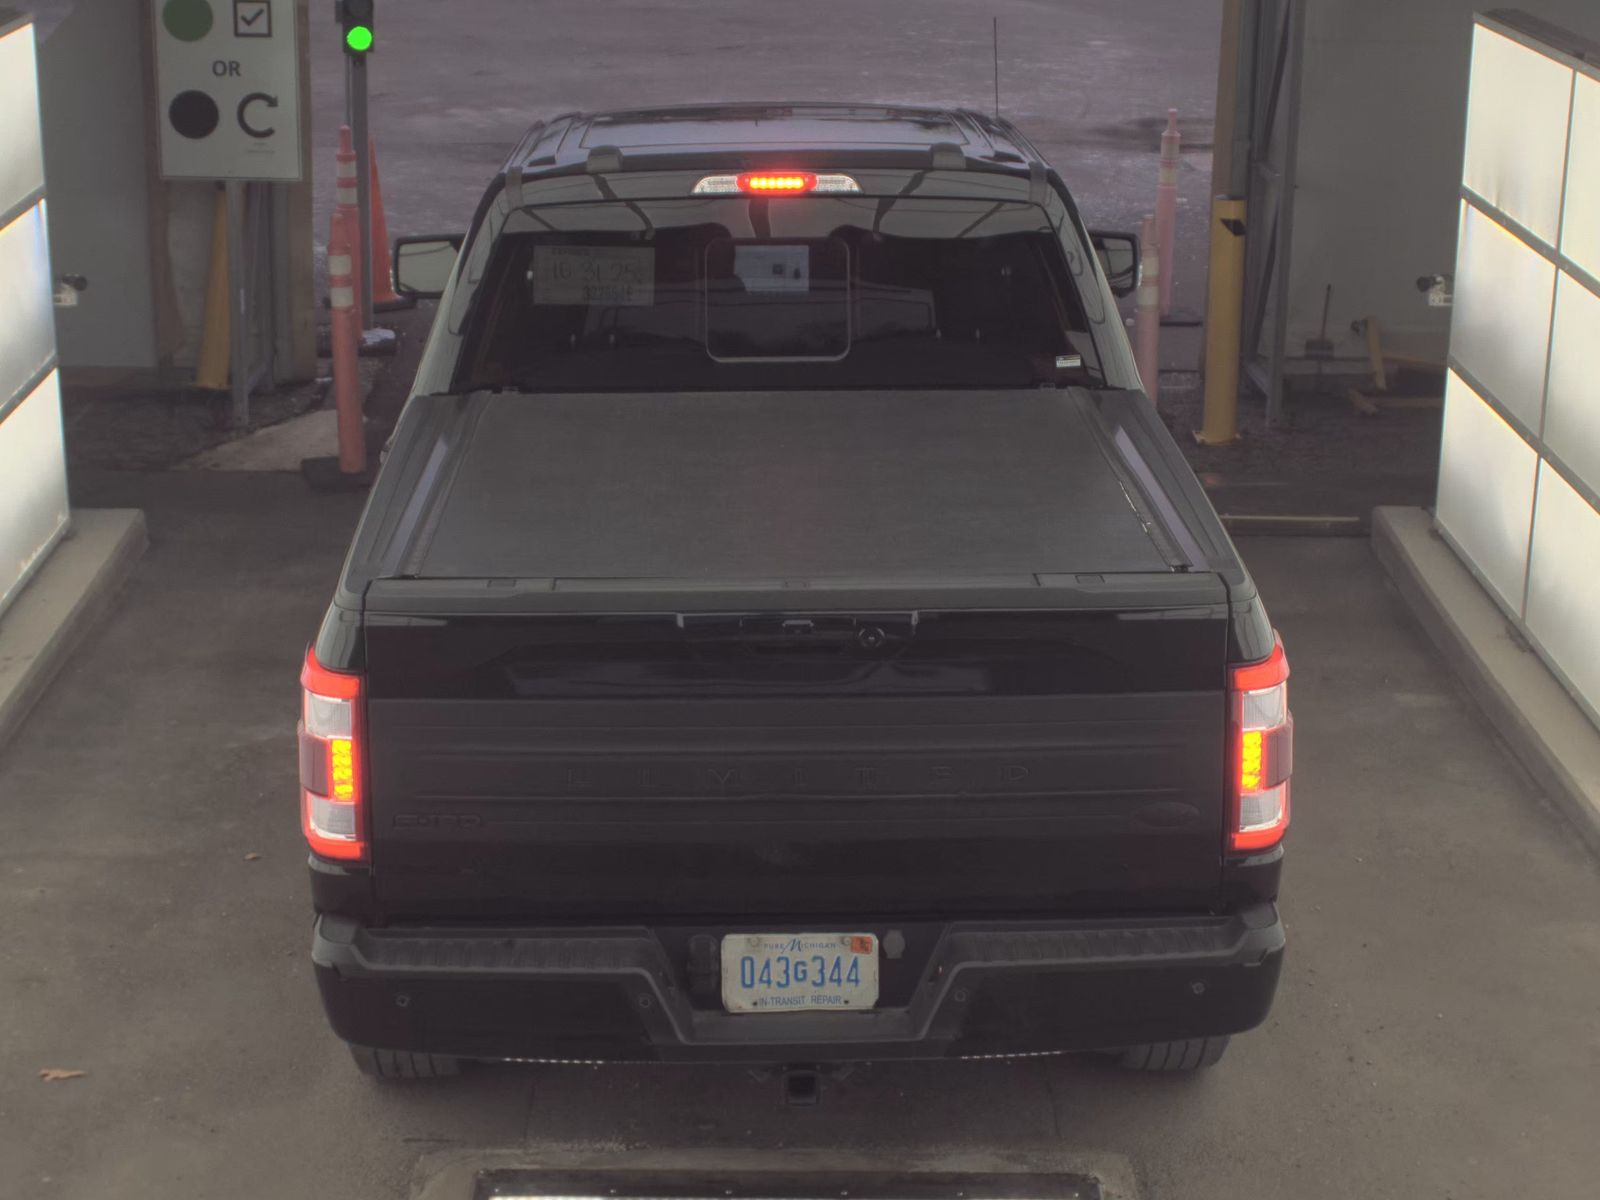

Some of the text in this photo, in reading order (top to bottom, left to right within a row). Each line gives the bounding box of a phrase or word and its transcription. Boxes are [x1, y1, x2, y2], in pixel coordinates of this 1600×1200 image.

[212, 60, 241, 77] OR
[566, 764, 1030, 790] LIMITED
[740, 955, 860, 989] 043G344
[811, 995, 842, 1005] REPAIR
